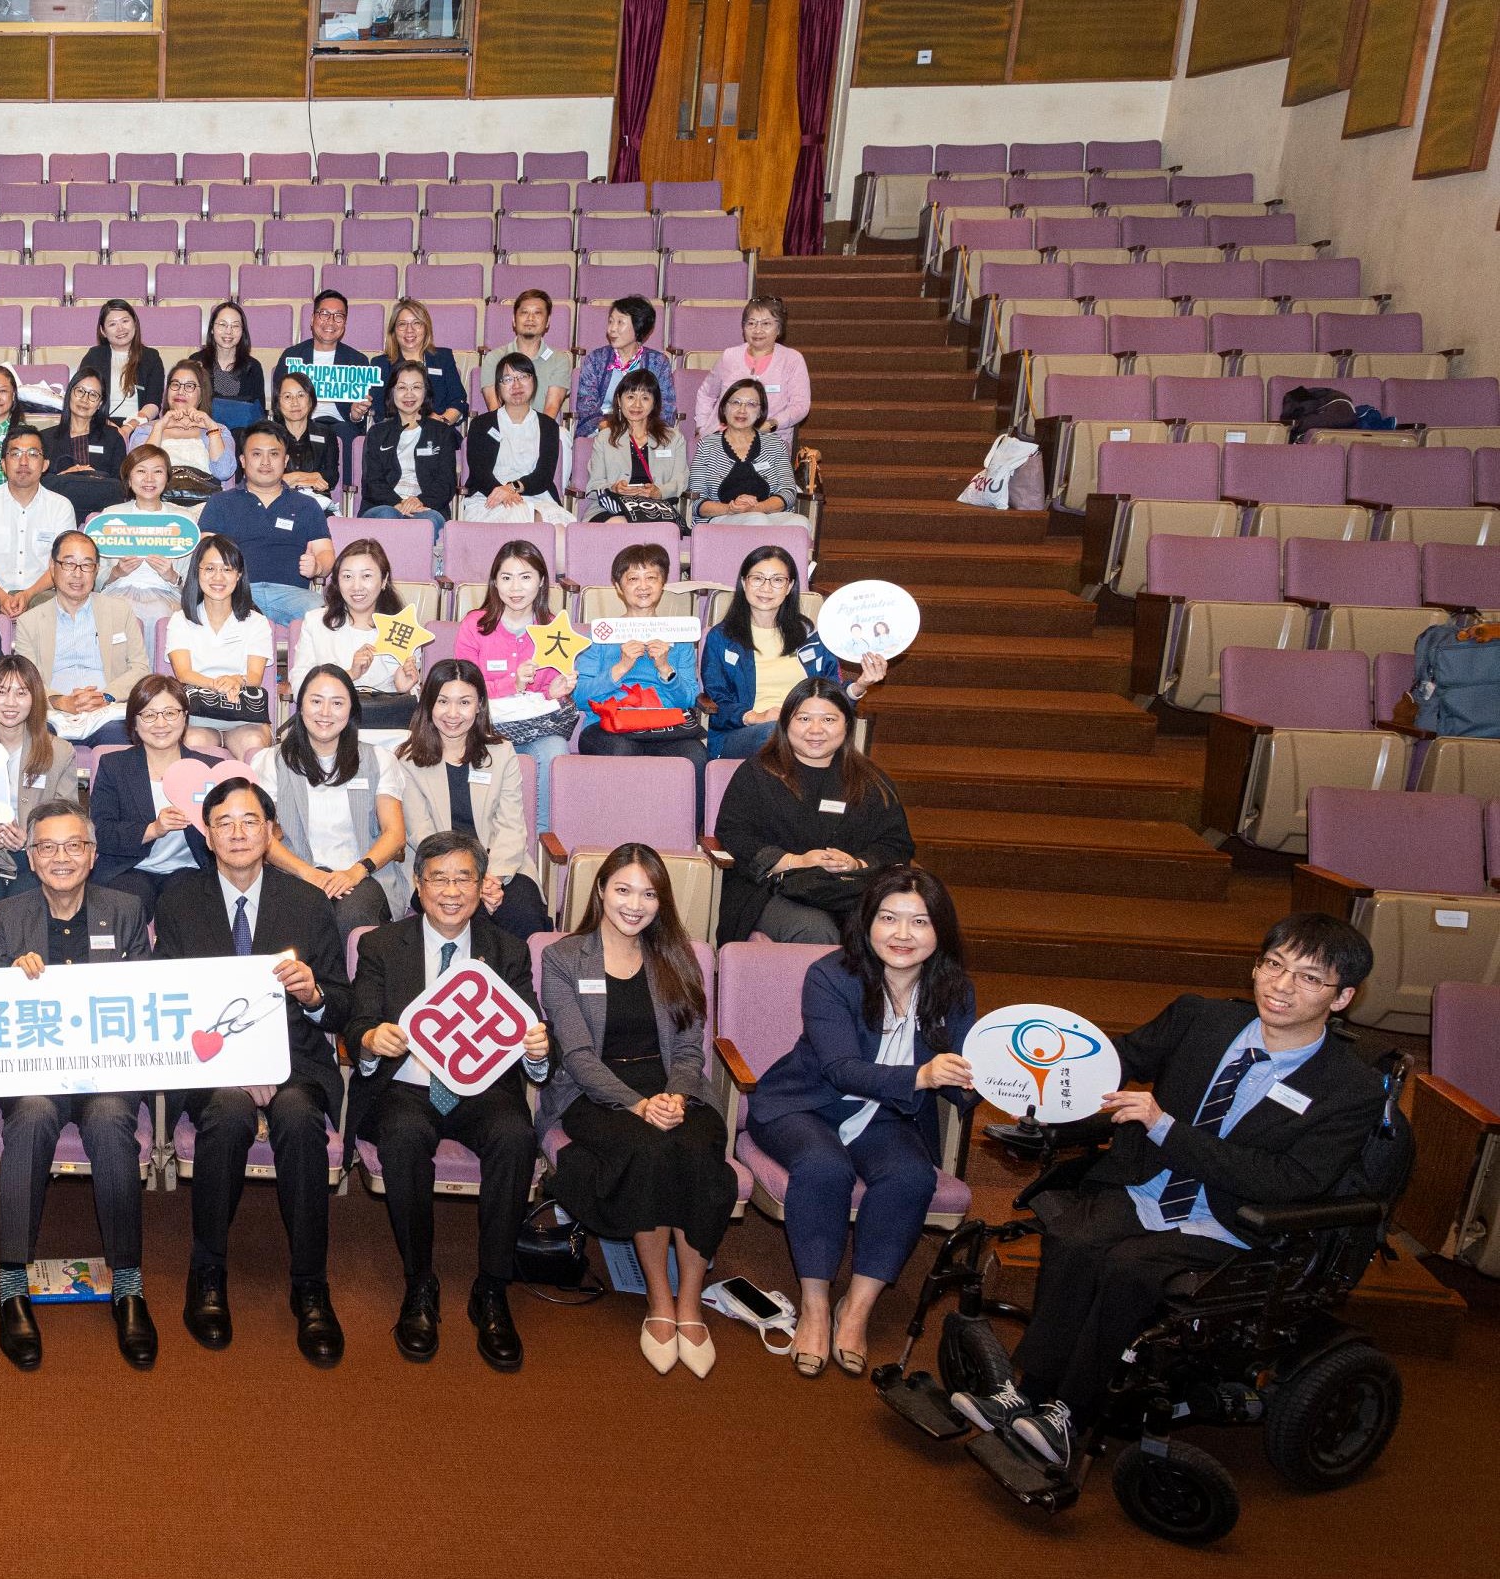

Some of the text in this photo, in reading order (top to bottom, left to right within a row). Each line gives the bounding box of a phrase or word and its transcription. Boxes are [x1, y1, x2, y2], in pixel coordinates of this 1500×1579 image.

[312, 381, 368, 400] HERAPIST
[92, 536, 194, 547] SOCIAL WORKERS
[385, 620, 416, 648] 理
[546, 633, 571, 660] 大
[18, 1057, 55, 1072] MENTAL
[56, 1056, 90, 1071] HEALTH
[91, 1053, 132, 1069] SUPPORT
[133, 1050, 193, 1067] PROGRAMME
[984, 1076, 1030, 1092] School of
[991, 1087, 1031, 1102] Nursing
